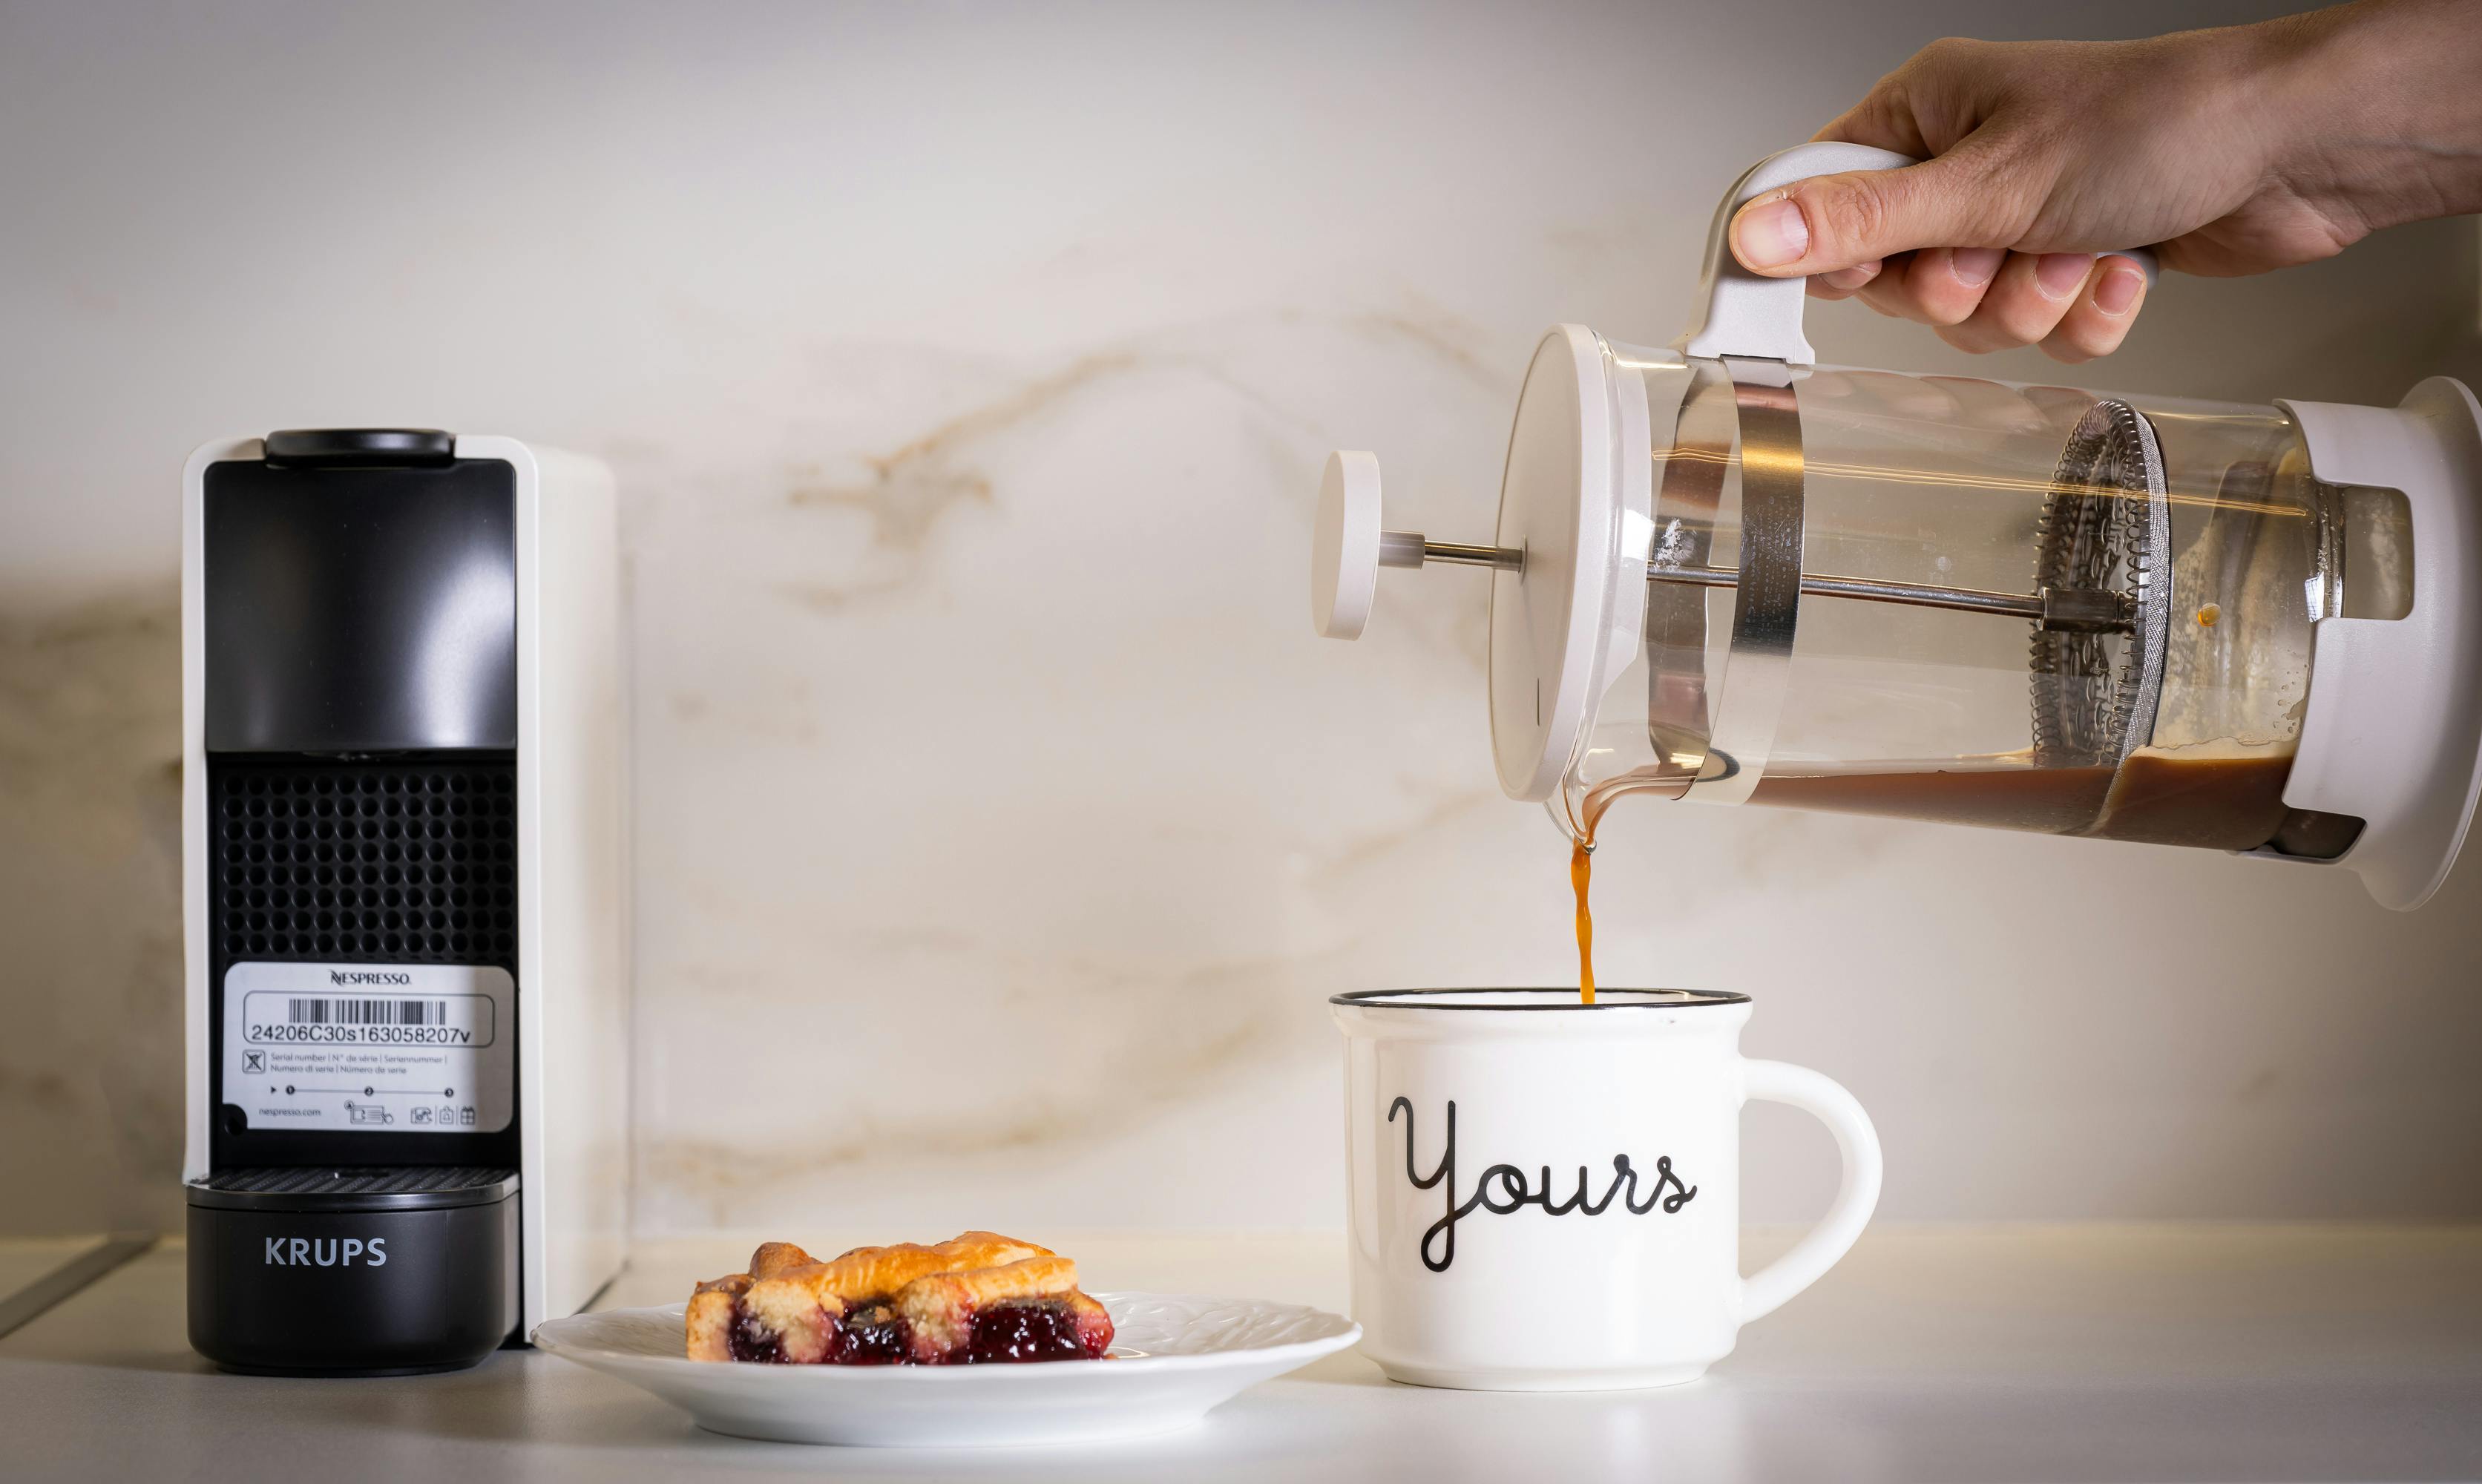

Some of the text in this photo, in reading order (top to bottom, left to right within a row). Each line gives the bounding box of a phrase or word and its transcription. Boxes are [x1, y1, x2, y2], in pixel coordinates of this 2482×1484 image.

[329, 970, 410, 987] NESPRESSO
[252, 1025, 470, 1043] 24206C30s163058207v
[271, 1053, 292, 1062] Serial
[295, 1053, 326, 1062] number
[346, 1054, 356, 1063] de
[384, 1054, 442, 1063] Seriennummer
[305, 1064, 312, 1073] di
[375, 1066, 385, 1074] de
[259, 1109, 321, 1117] nespresso.com
[1388, 1096, 1697, 1273] Yours
[266, 1237, 387, 1266] KRUPS
